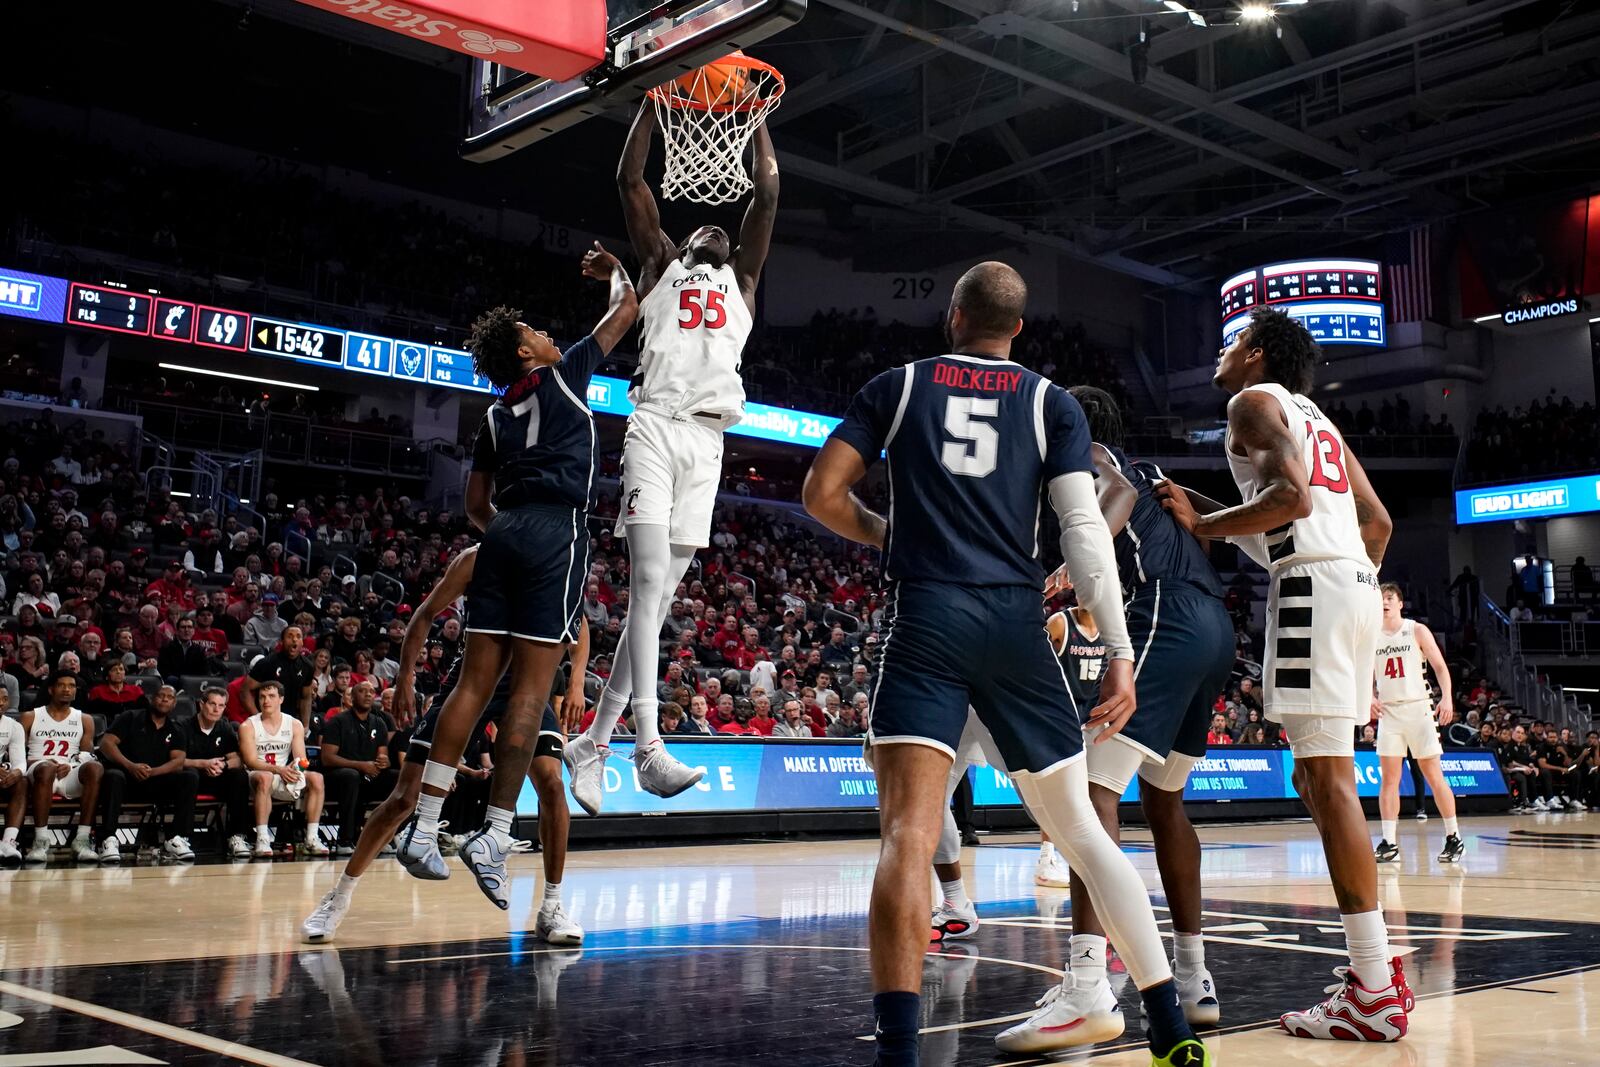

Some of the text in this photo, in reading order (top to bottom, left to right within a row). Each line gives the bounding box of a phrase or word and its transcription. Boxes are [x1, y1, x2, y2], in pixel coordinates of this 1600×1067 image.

[530, 222, 569, 248] 218
[892, 277, 935, 299] 219
[79, 290, 137, 311] TOL 3
[678, 288, 728, 330] 55
[1504, 299, 1578, 323] CHAMPIONS
[78, 308, 135, 328] FLS 2
[207, 312, 238, 344] 49
[274, 325, 325, 358] 15:42
[357, 339, 381, 369] 41
[436, 353, 454, 365] TOL
[436, 369, 452, 381] FLS
[933, 362, 1023, 393] DOCKERY
[511, 392, 541, 449] 7
[801, 417, 831, 438] 21+
[941, 395, 1000, 478] 5
[1474, 488, 1564, 513] BUD LIGHT
[1069, 644, 1105, 657] HOWAR
[1079, 658, 1103, 680] 15
[1384, 656, 1406, 679] 41
[36, 728, 79, 738] CINCINNATI
[43, 739, 70, 757] 22
[783, 756, 818, 773] MAKE
[819, 756, 829, 773] A
[839, 779, 865, 796] JOIN
[1192, 777, 1248, 790] JOIN US TODAY.
